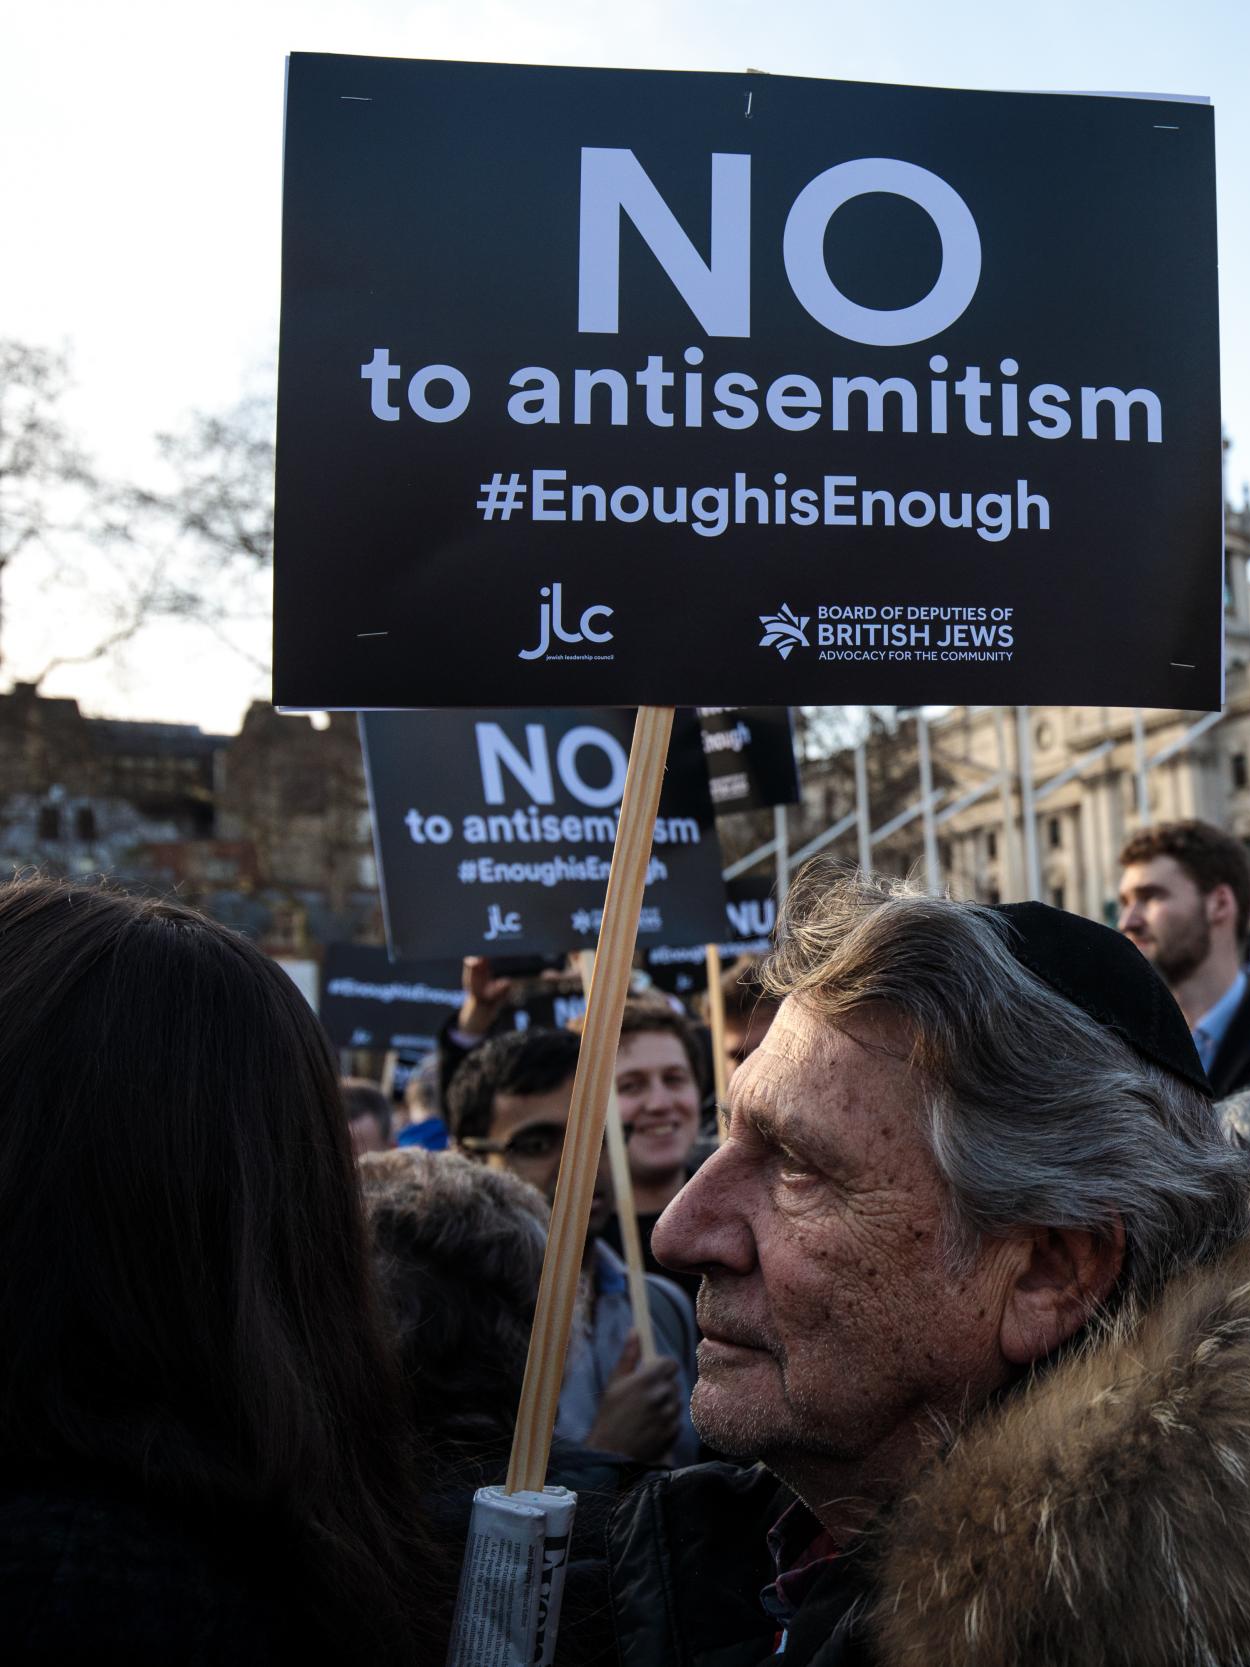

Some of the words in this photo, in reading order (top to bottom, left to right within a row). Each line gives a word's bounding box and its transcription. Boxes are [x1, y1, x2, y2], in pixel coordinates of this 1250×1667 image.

[578, 147, 982, 346] NO
[361, 348, 471, 423] to
[507, 346, 1163, 443] antisemitism
[477, 470, 1050, 543] #EnoughisEnough
[518, 583, 614, 660] jlc
[819, 606, 876, 620] BOARD
[881, 607, 903, 620] OF
[908, 607, 986, 621] DEPUTIES
[991, 608, 1013, 621] OF
[819, 624, 930, 647] BRITISH
[937, 625, 1014, 647] JEWS
[819, 650, 885, 661] ADVOCACY
[889, 651, 912, 661] FOR
[915, 651, 938, 661] THE
[941, 651, 1013, 662] COMMUNITY
[475, 722, 629, 808] NO
[404, 807, 453, 844] to
[463, 806, 701, 845] antisemsm
[458, 855, 668, 887] #EnoughisEngh
